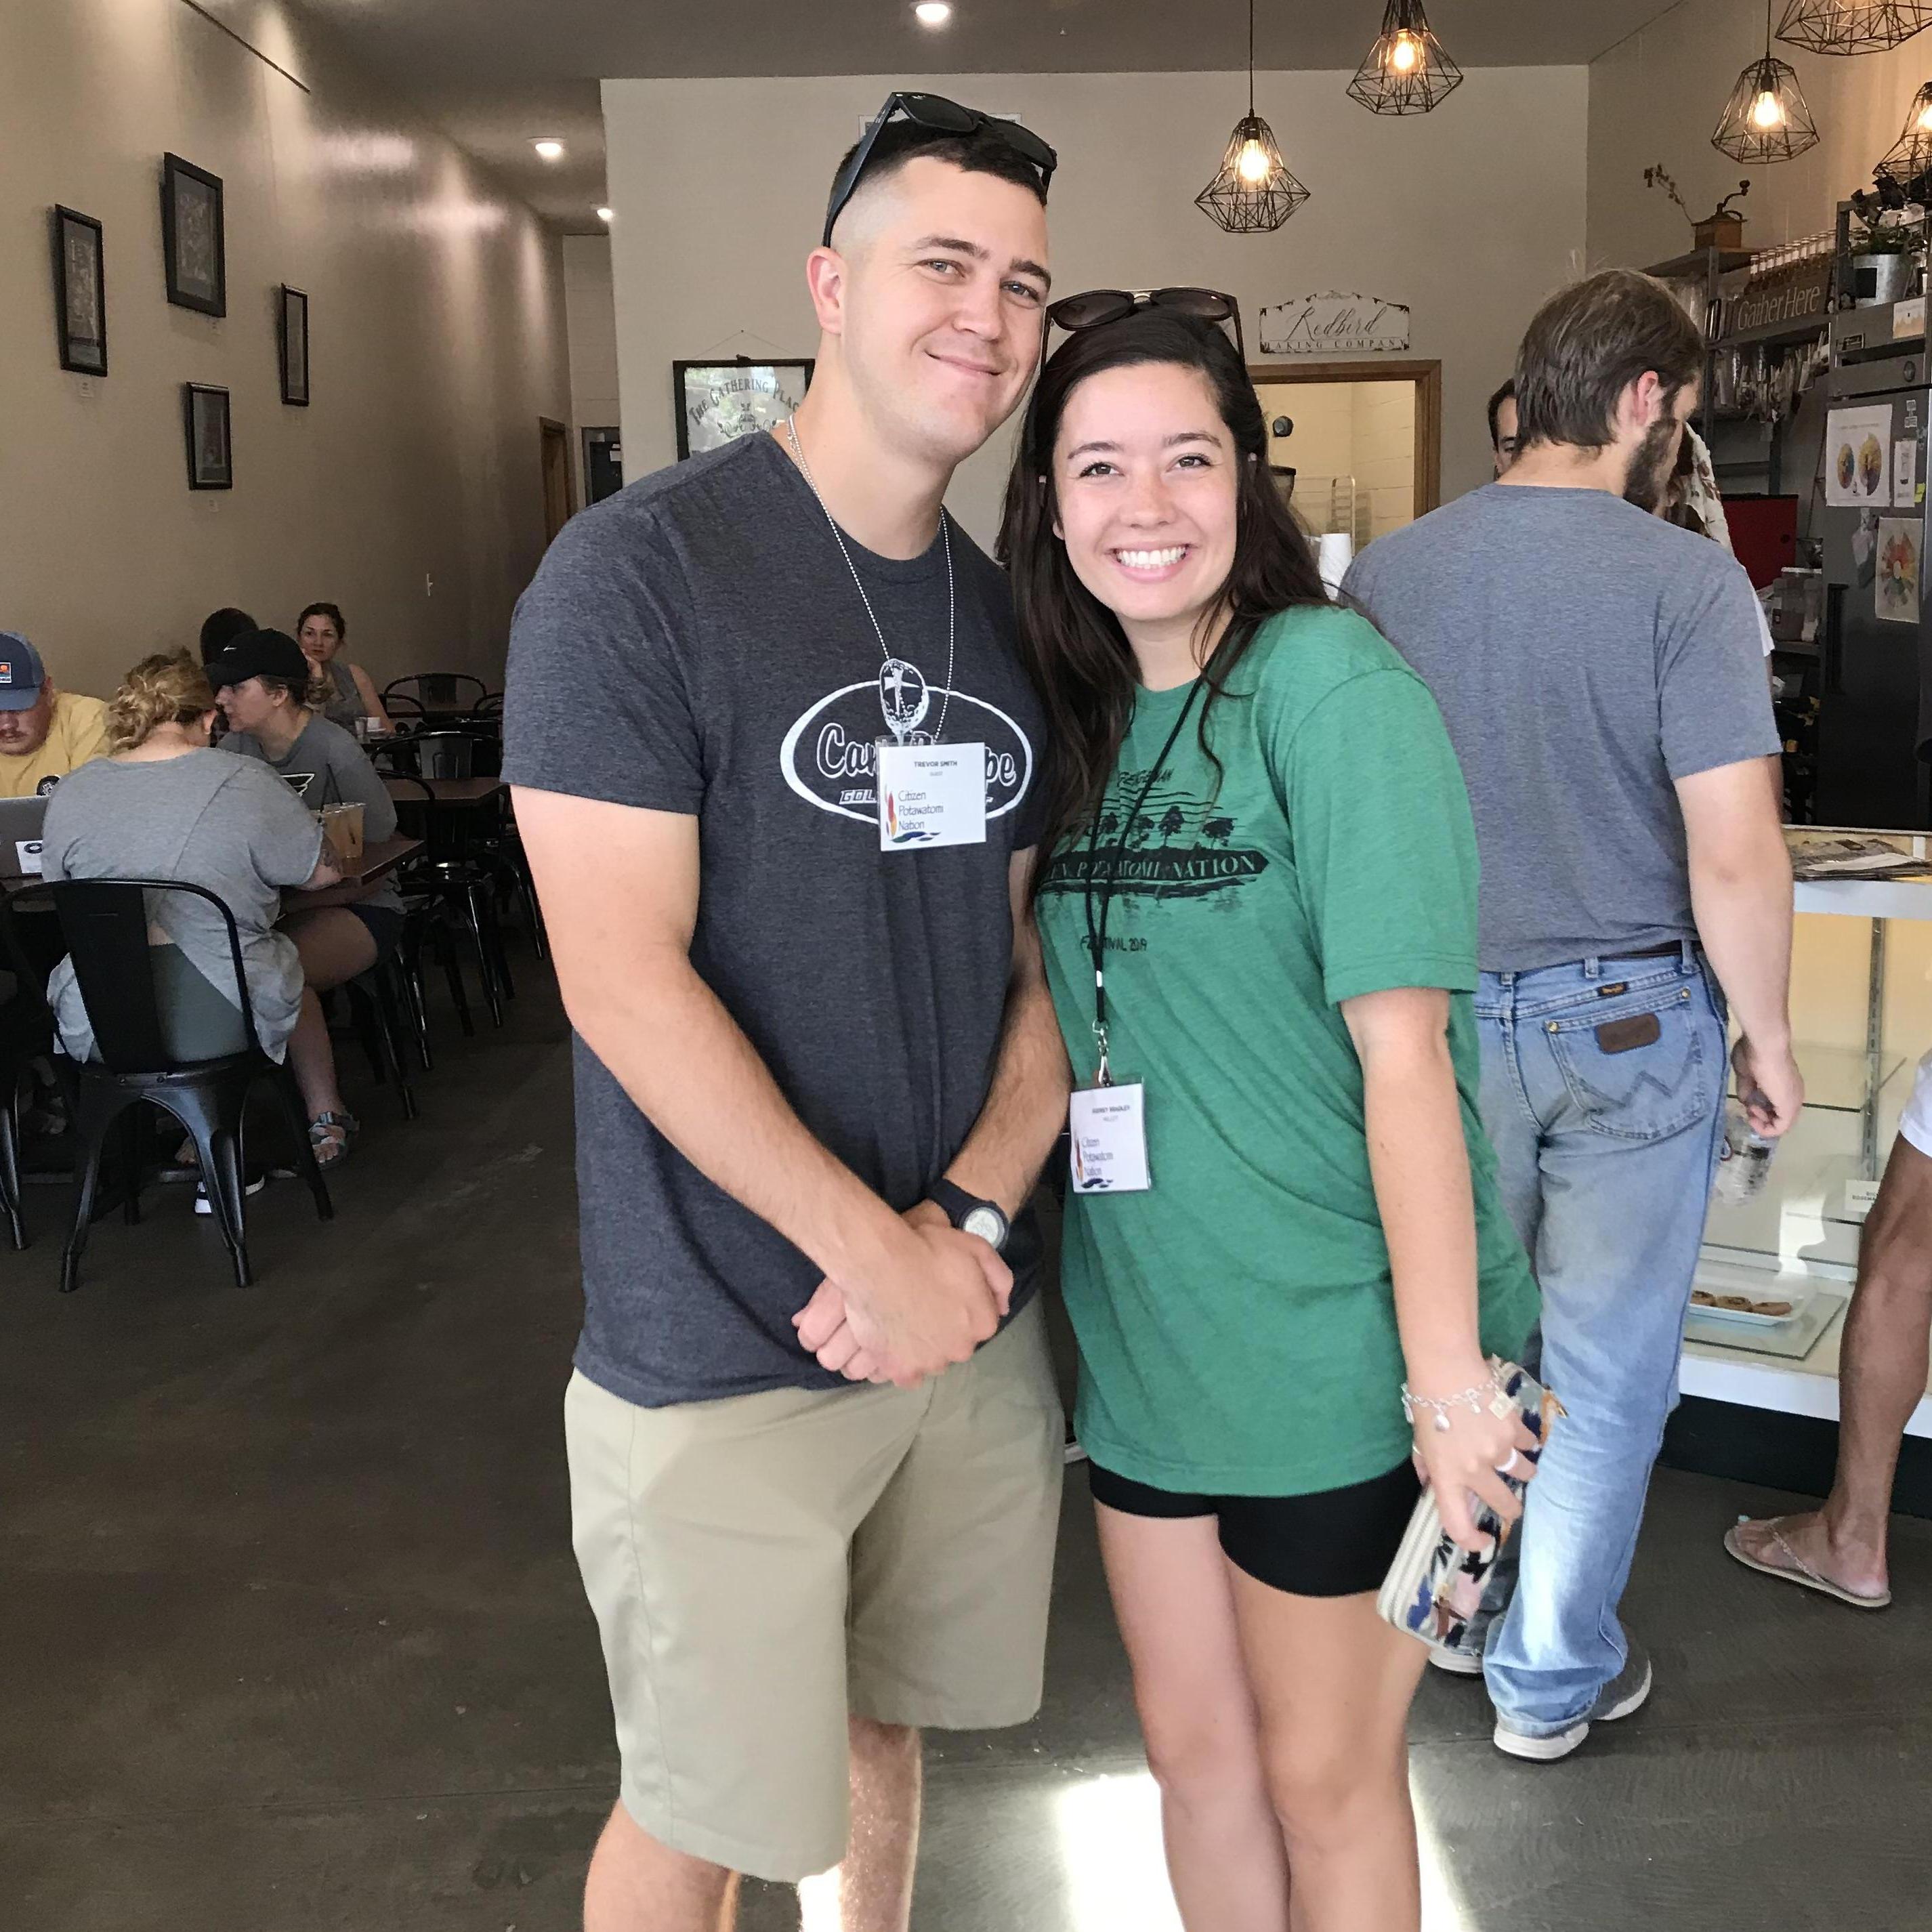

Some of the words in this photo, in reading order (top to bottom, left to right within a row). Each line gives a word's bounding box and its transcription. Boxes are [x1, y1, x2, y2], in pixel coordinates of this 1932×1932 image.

[1738, 293, 1784, 330] Gather
[1782, 286, 1820, 320] Here
[1284, 306, 1387, 341] Redbird
[1334, 339, 1404, 348] COMPANY
[898, 790, 927, 801] Citizen
[898, 804, 944, 816] Potawatomi
[898, 820, 925, 831] Nation
[1173, 855, 1256, 879] NATION
